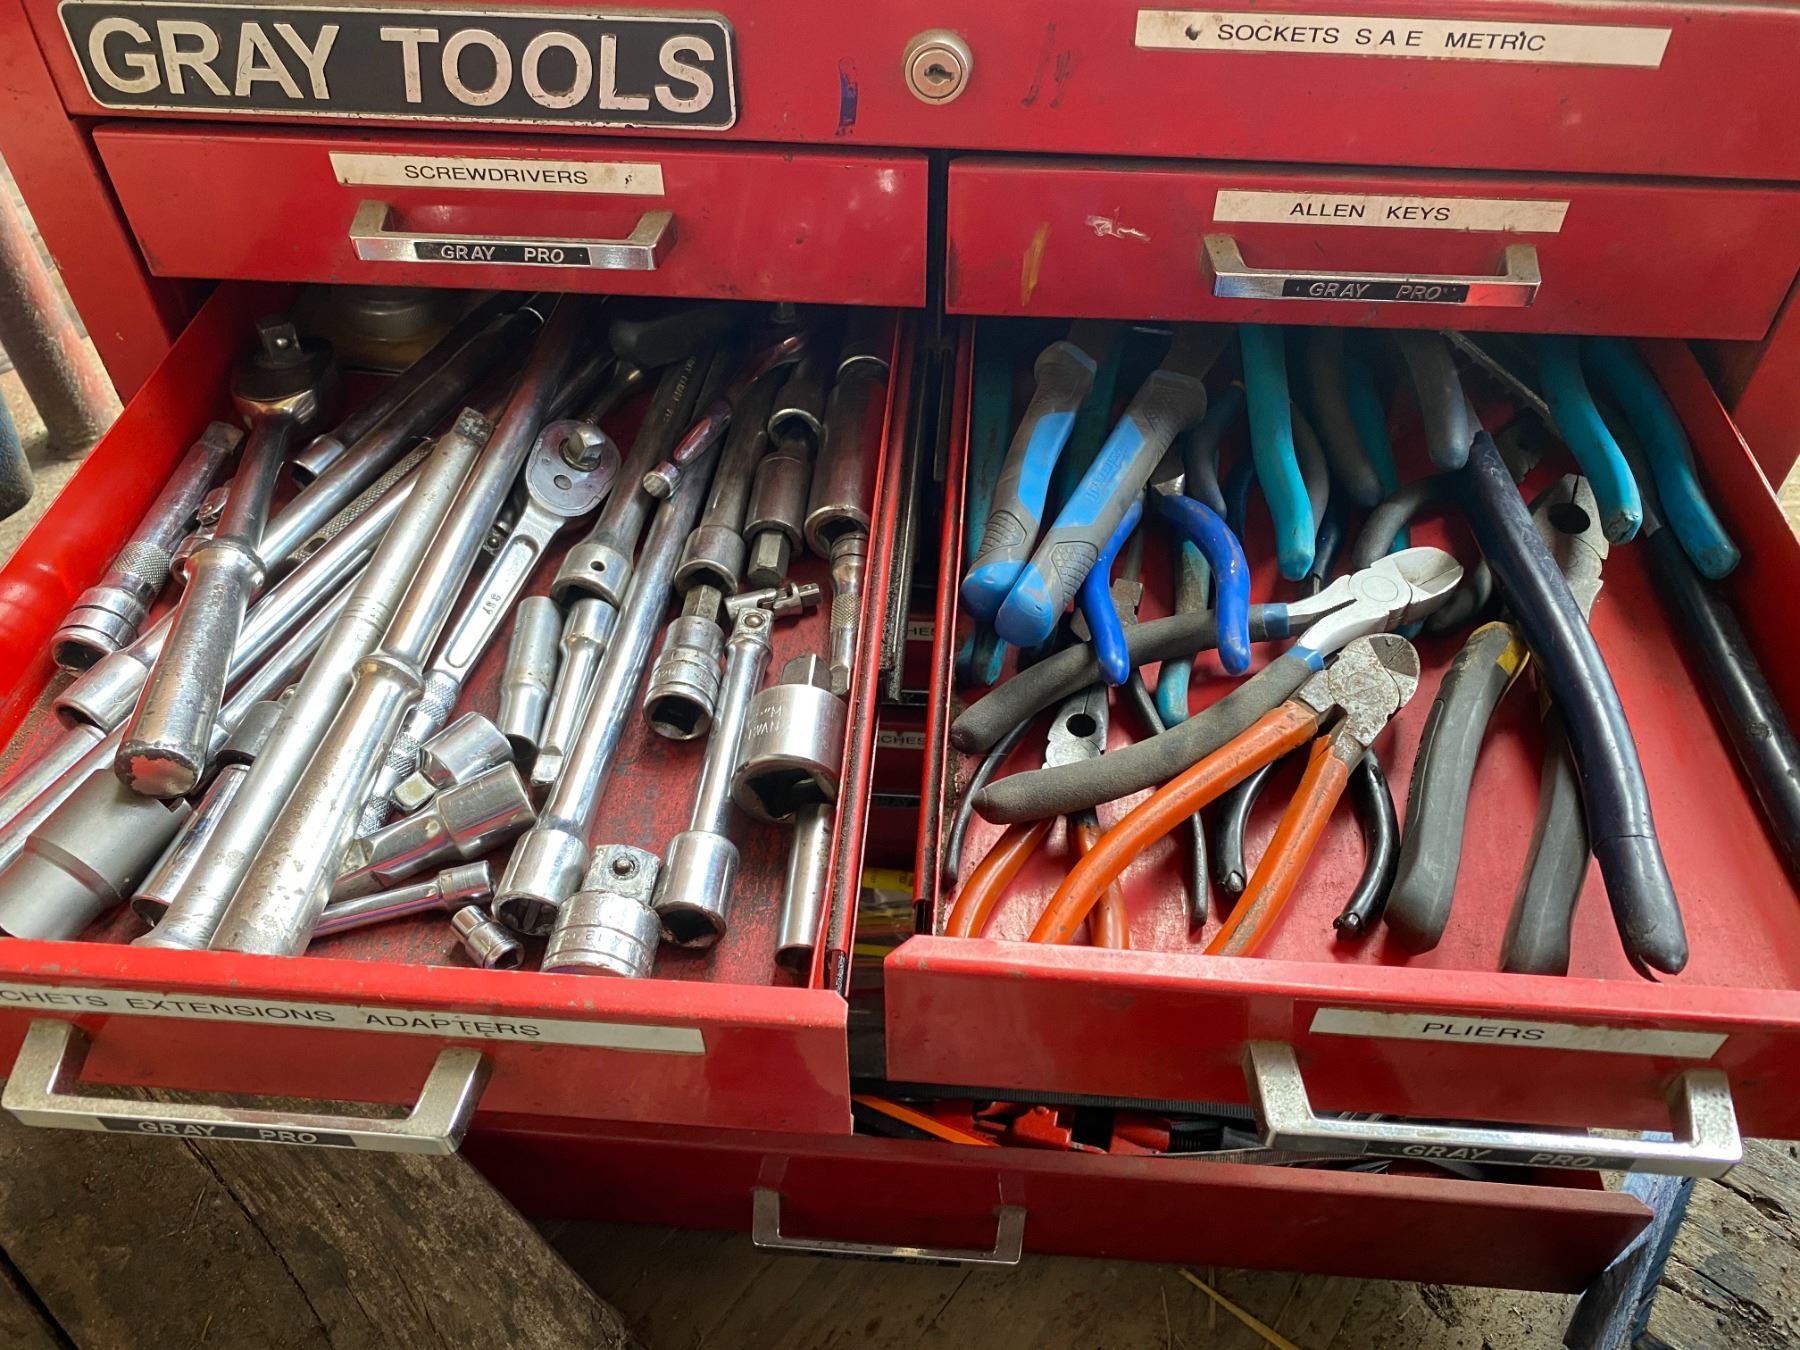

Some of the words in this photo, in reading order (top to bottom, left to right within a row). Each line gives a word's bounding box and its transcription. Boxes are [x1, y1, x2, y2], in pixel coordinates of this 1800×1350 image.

[1218, 24, 1340, 44] SOCKETS
[1444, 31, 1546, 51] METRIC
[88, 17, 340, 99] GRAY
[380, 27, 715, 113] TOOLS
[404, 165, 588, 185] SCREWDRIVERS
[1290, 202, 1365, 218] ALLEN
[1386, 206, 1451, 221] KEYS
[441, 245, 496, 260] GRAY
[524, 247, 564, 263] PRO
[1309, 281, 1371, 298] GRAY
[1395, 286, 1442, 301] PRO
[0, 989, 108, 1007] CHETS
[125, 998, 336, 1022] EXTENSIONS
[366, 1014, 541, 1037] ADAPTERS
[1422, 1022, 1545, 1041] PLIERS
[138, 1121, 216, 1137] GRAY
[258, 1129, 317, 1144] PRO
[1402, 1145, 1492, 1160] GRAY
[1529, 1152, 1596, 1168] PRO
